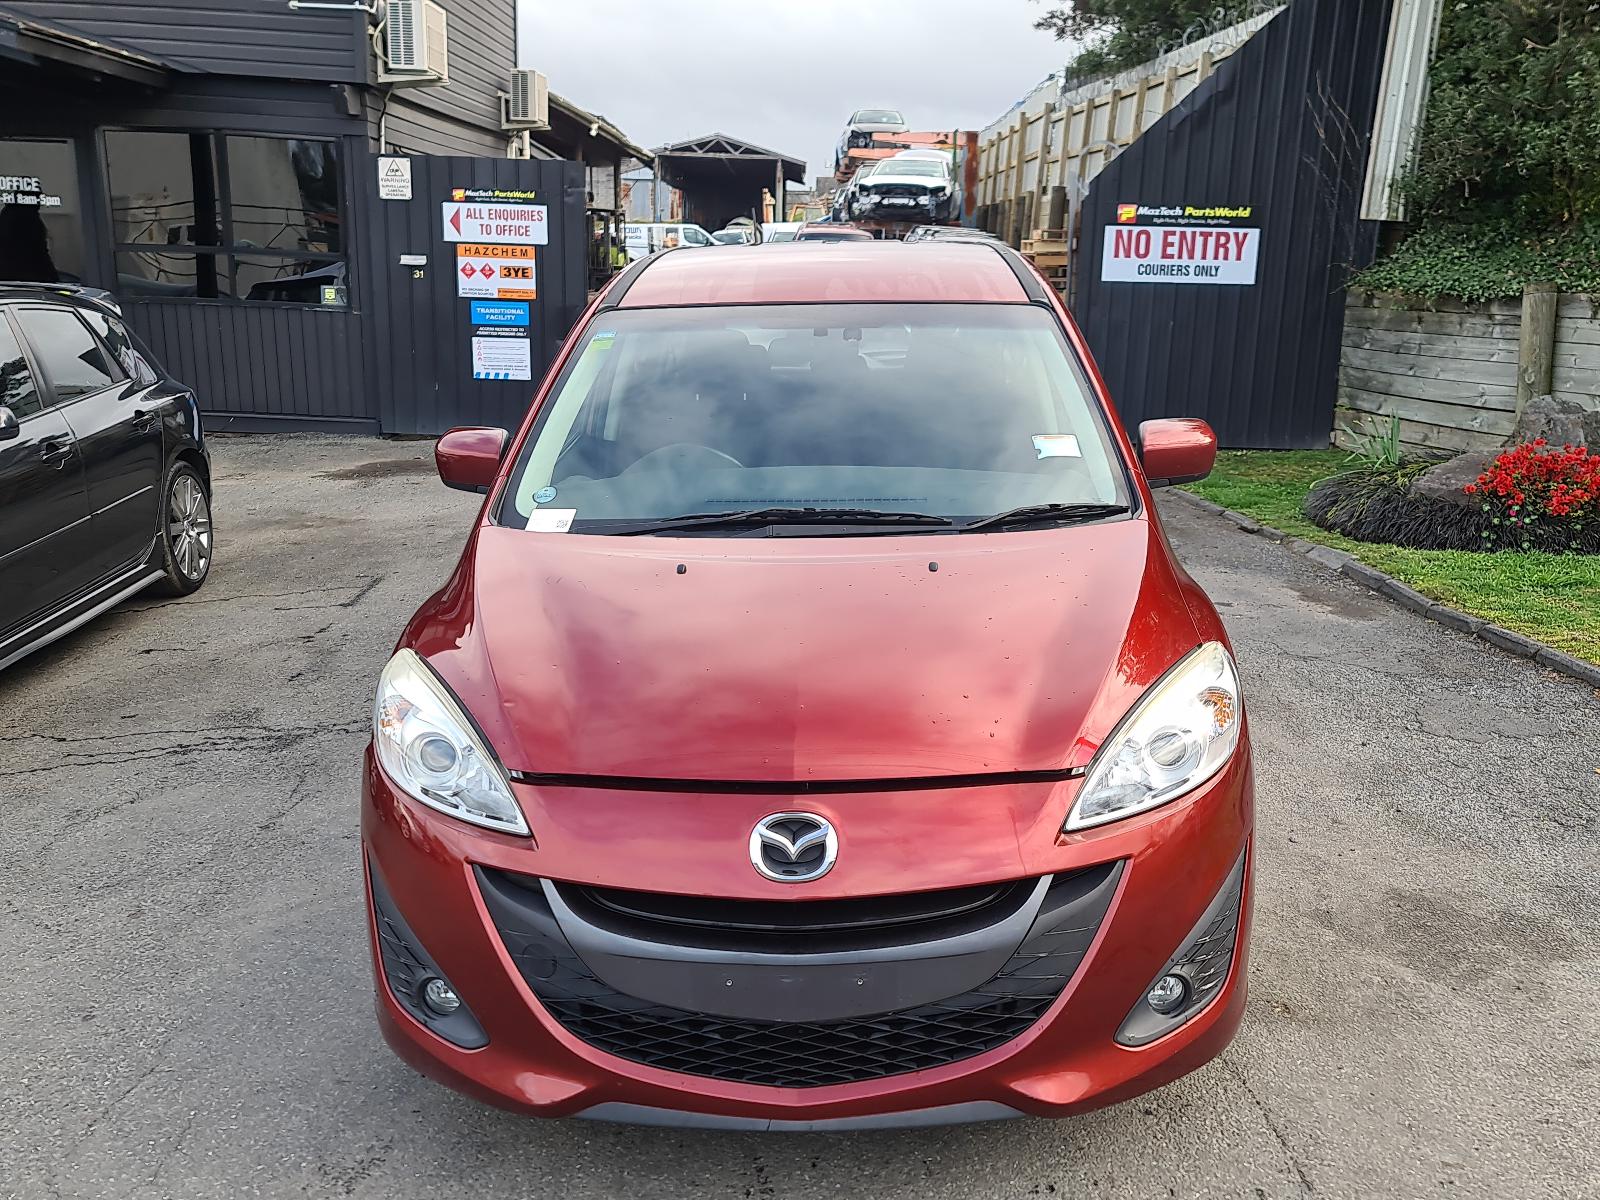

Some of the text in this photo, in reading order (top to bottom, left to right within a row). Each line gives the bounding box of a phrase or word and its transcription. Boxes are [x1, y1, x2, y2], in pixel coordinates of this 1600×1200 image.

[0, 176, 40, 191] OFFICE
[16, 193, 61, 206] 8am-5pm
[494, 190, 536, 199] PartsWorld
[466, 208, 544, 222] ALL ENQUIRIES
[1136, 206, 1251, 218] MazTech PartsWorld
[480, 224, 530, 236] TO OFFICE
[464, 246, 528, 257] HAZCHEM
[1114, 230, 1249, 261] NO ENTRY
[412, 270, 424, 278] 31
[504, 266, 529, 278] 3YE
[1138, 264, 1221, 278] COURIERS ONLY
